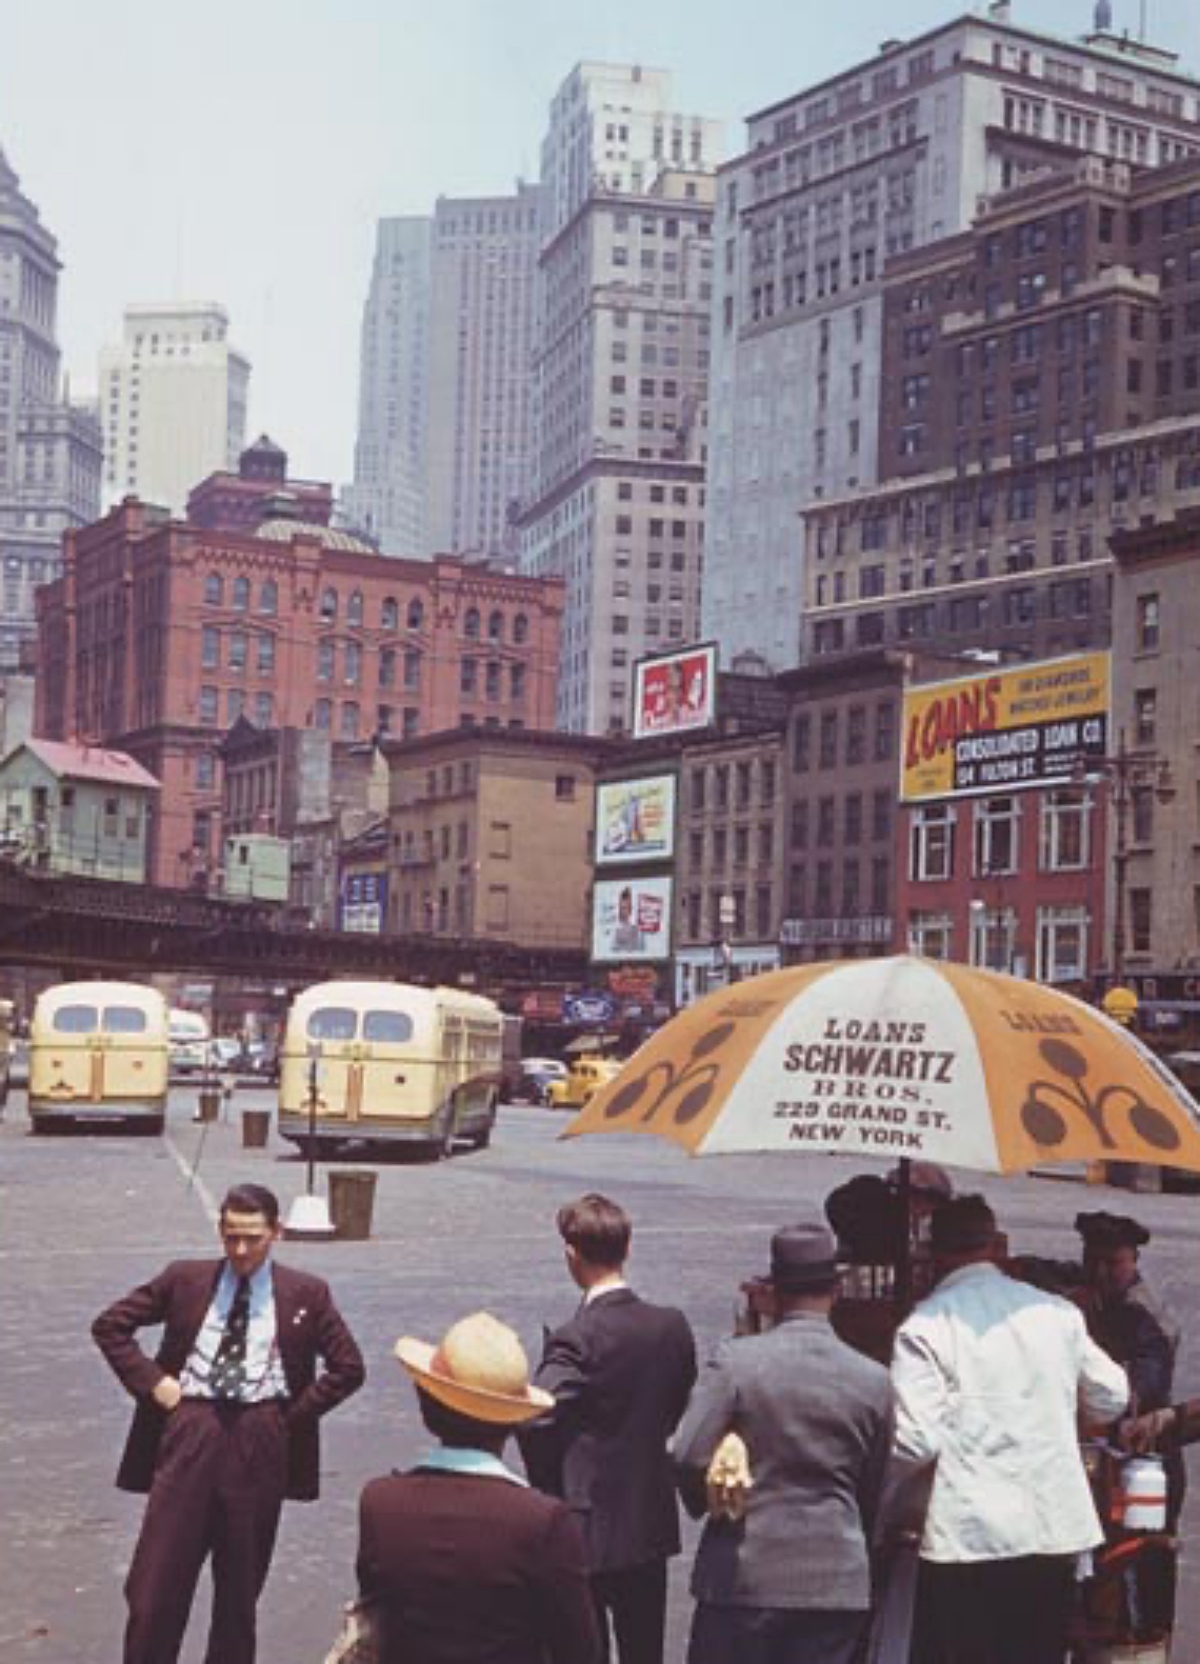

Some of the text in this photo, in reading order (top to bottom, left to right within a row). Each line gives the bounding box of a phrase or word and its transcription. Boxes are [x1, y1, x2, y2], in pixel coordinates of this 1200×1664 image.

[906, 678, 1001, 769] LOANS
[1045, 723, 1078, 749] LOAN
[823, 1018, 926, 1044] LOANS
[783, 1044, 956, 1083] SCHWARTZ
[812, 1078, 934, 1105] BROS.
[773, 1101, 952, 1131] 229 GRAND ST.
[788, 1122, 922, 1148] NEW YORK
